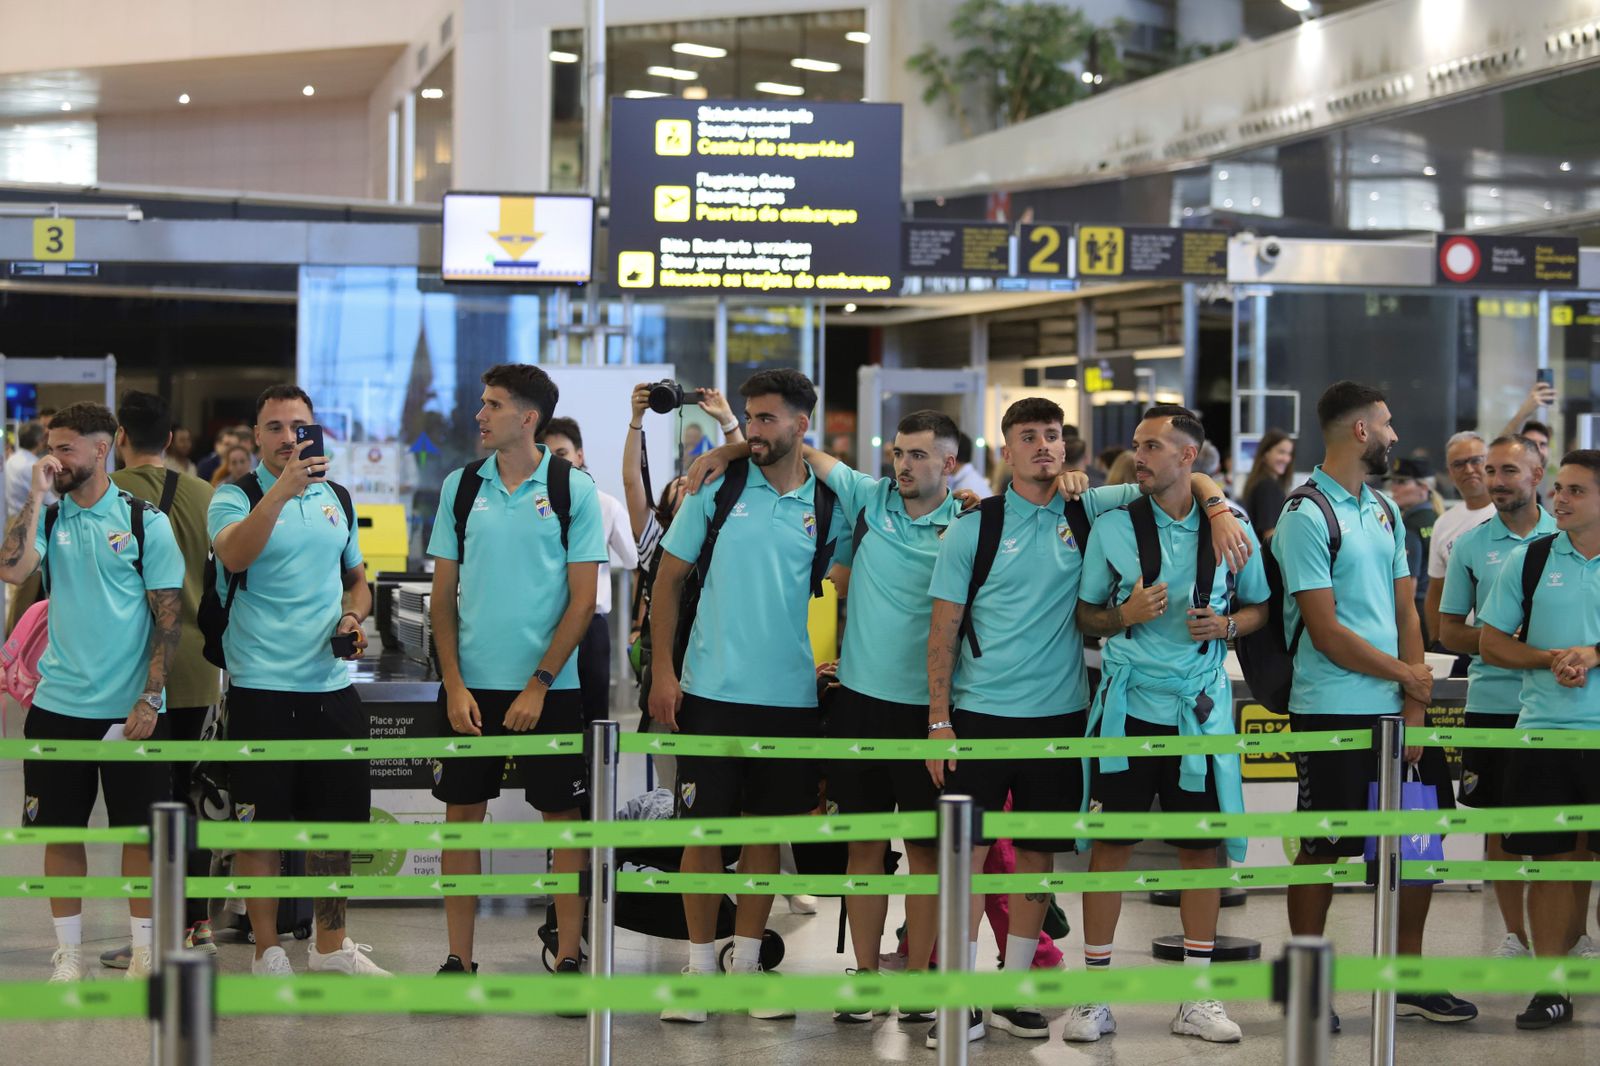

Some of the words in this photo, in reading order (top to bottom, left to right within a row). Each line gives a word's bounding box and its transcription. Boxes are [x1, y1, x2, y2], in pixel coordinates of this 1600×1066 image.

[698, 122, 747, 140] Security
[747, 123, 790, 139] control
[697, 138, 755, 156] Control
[756, 139, 776, 156] de
[778, 140, 854, 160] seguridad
[696, 188, 749, 206] Boarding
[696, 204, 757, 222] Puertas
[758, 205, 779, 222] de
[780, 206, 857, 226] embarque
[46, 226, 64, 253] 3
[1029, 226, 1060, 273] 2
[781, 256, 810, 271] card
[660, 269, 721, 287] Muestre
[722, 273, 742, 288] su
[743, 271, 793, 291] tarjeta
[794, 272, 815, 289] de
[815, 272, 891, 292] embarque
[1426, 706, 1446, 715] osite
[370, 716, 393, 725] Place
[396, 717, 414, 726] your
[1432, 715, 1455, 724] cción
[370, 726, 406, 736] personal
[370, 758, 408, 766] overcoat,
[370, 767, 412, 778] inspection
[413, 854, 441, 864] Disinfe
[414, 866, 435, 876] trays
